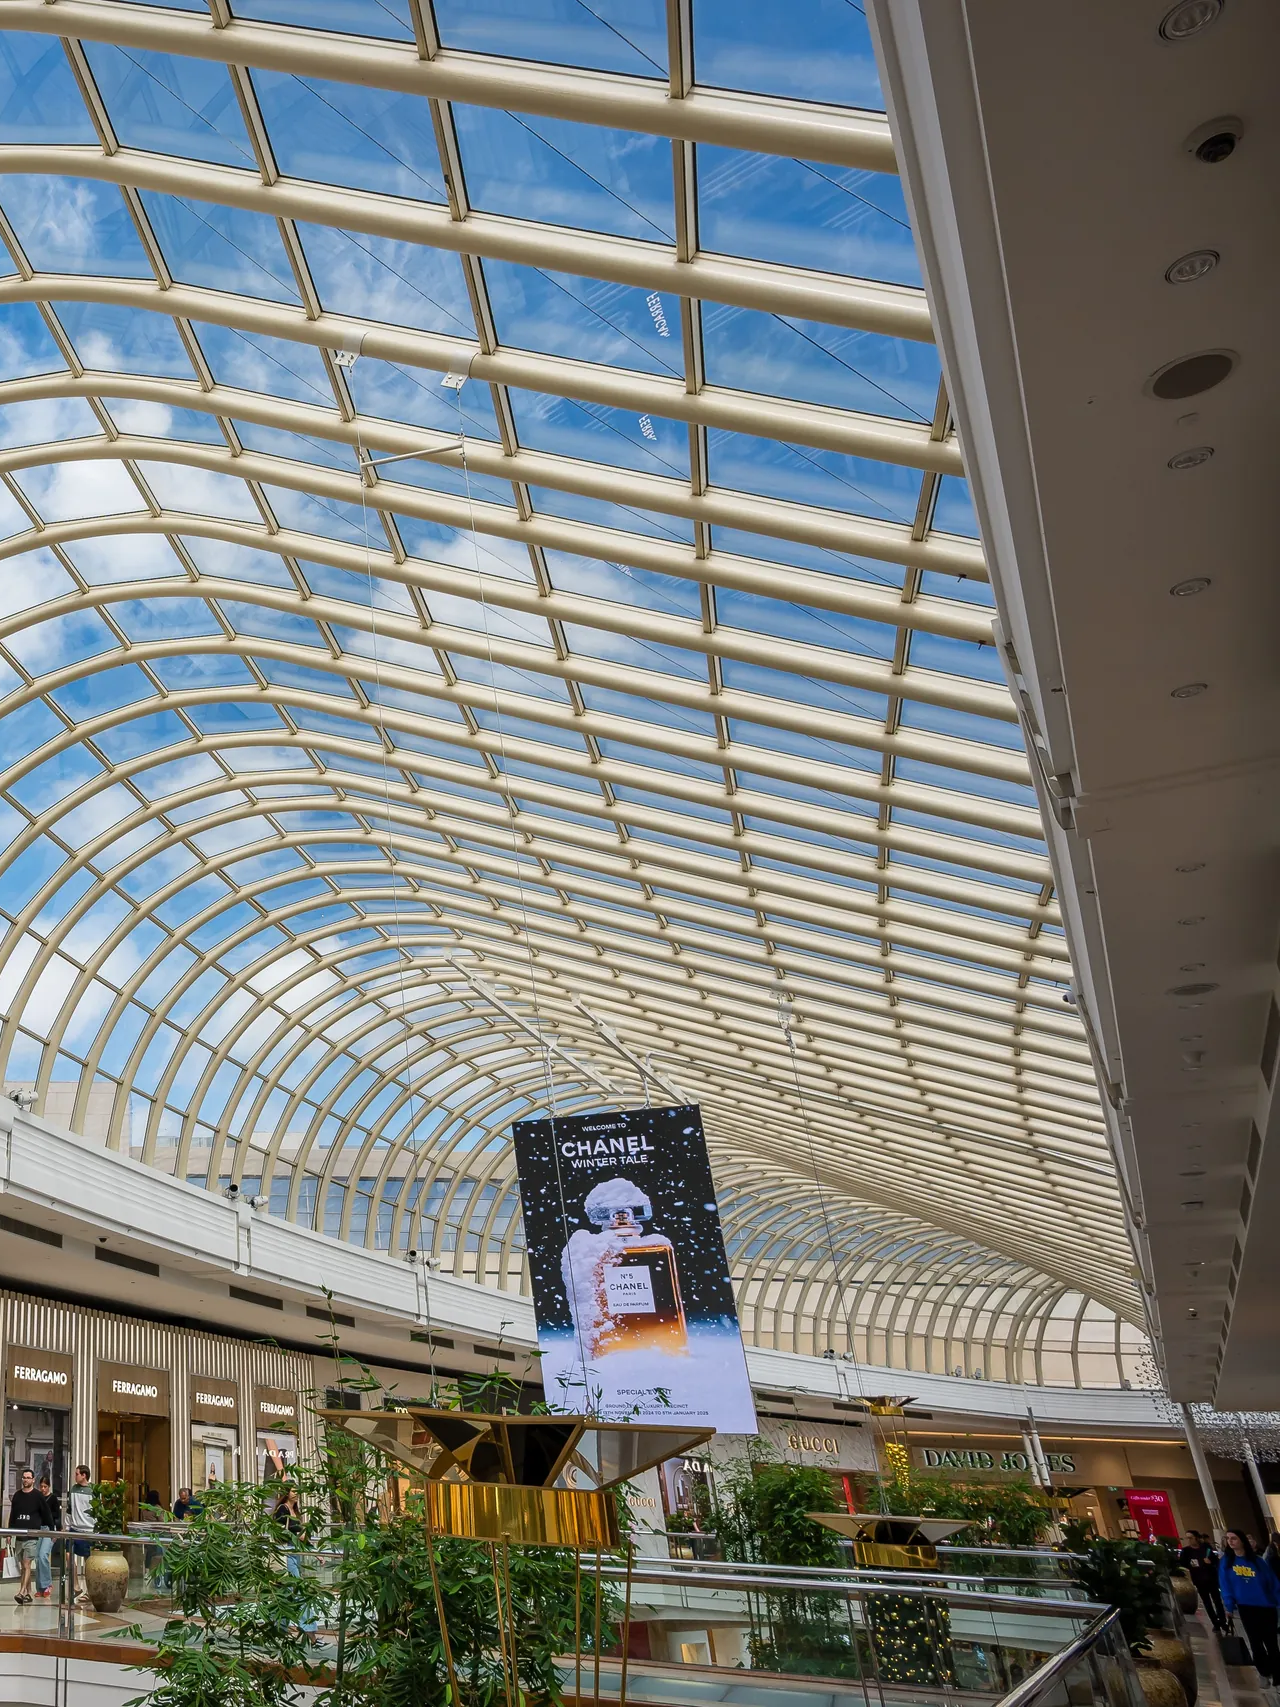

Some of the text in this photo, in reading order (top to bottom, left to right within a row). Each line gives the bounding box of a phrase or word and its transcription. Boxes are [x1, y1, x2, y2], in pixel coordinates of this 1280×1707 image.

[581, 1123, 617, 1132] WELCOME
[561, 1135, 655, 1158] CHANEL
[571, 1154, 649, 1169] WINTER TALE
[609, 1282, 649, 1291] CHANEL
[14, 1365, 68, 1386] FERRAGAMO
[112, 1380, 158, 1398] FERRAGAMO
[648, 1388, 672, 1396] EVNT
[195, 1392, 235, 1408] FERRAGAMO
[260, 1401, 295, 1417] FERRAGAMO
[787, 1434, 840, 1455] GUCCI
[922, 1449, 995, 1469] DAVID
[628, 1496, 657, 1508] GUCCI
